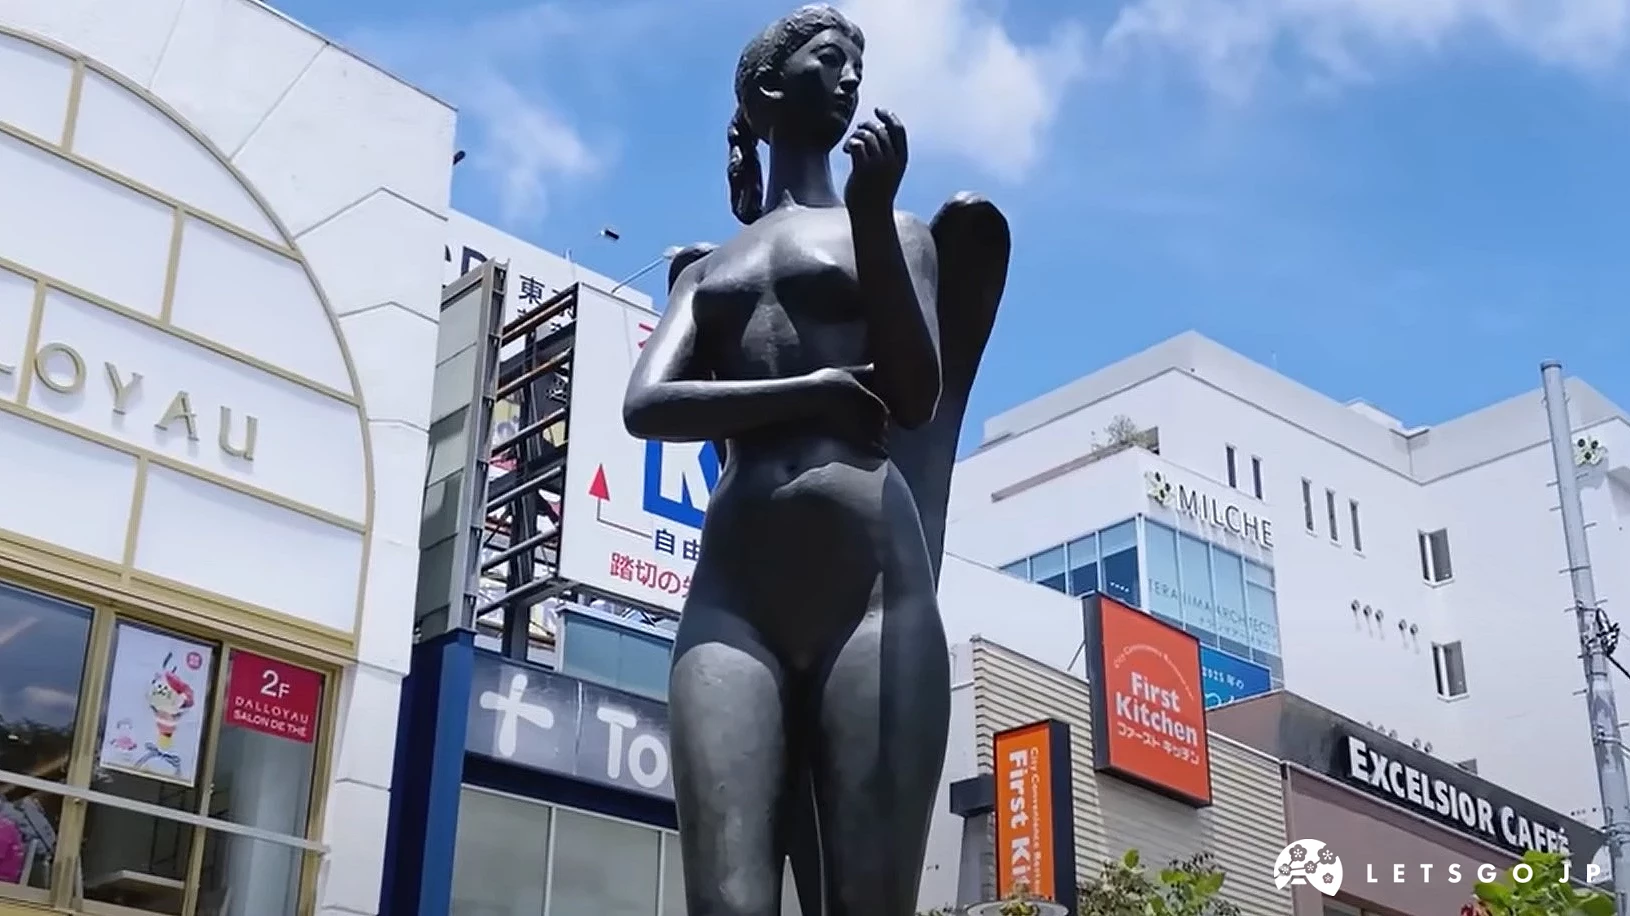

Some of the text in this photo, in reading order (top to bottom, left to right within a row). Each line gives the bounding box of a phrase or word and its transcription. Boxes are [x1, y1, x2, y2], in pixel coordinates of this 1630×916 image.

[1178, 484, 1274, 548] MILCHE
[260, 669, 290, 698] 2F
[1131, 671, 1181, 713] First
[233, 708, 270, 728] SALON
[234, 695, 310, 725] DALLOYAU
[1115, 691, 1198, 747] Kitchen
[1117, 721, 1161, 748] ファースト
[1009, 749, 1029, 829] First
[1348, 736, 1497, 836] EXCELSIOR
